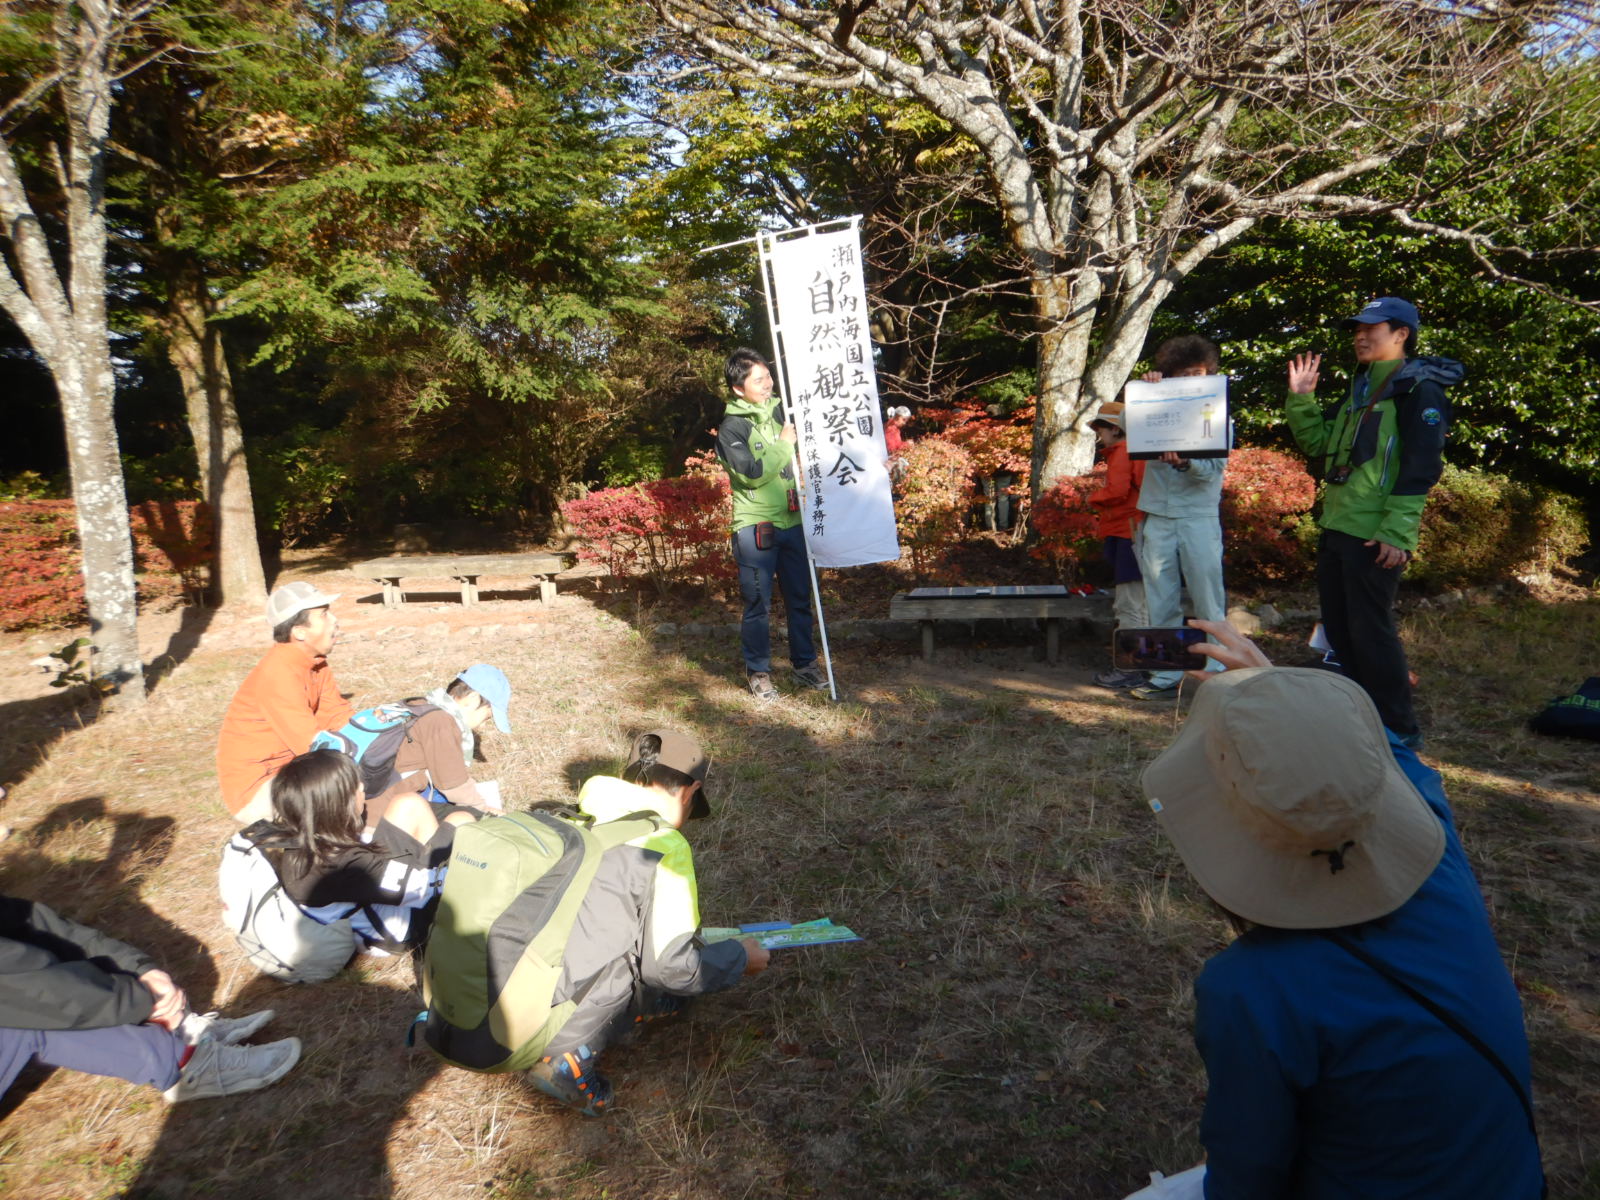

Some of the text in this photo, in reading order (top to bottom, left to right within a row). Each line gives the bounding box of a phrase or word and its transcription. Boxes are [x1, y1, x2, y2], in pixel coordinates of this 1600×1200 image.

[808, 269, 865, 487] 自然観察会
[831, 243, 873, 438] 瀬戸内海国立公園
[797, 389, 827, 537] 神戸自然保護官事務所
